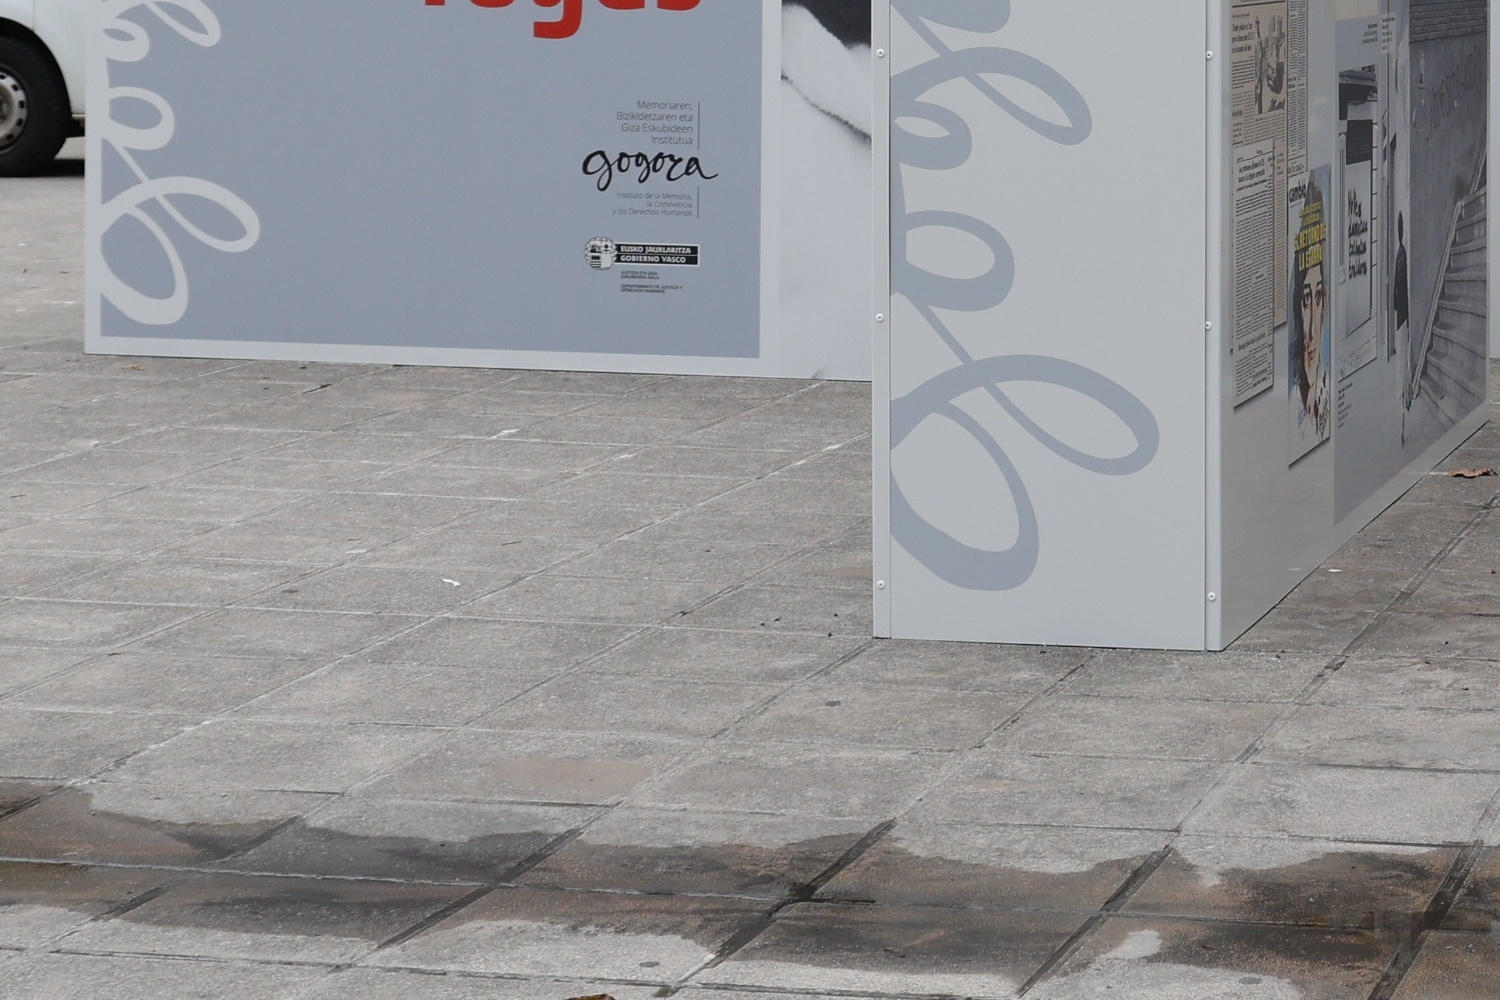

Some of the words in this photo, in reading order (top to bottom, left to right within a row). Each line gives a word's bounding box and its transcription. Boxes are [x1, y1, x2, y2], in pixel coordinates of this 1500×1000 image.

[637, 100, 693, 111] Memoriaren,
[616, 111, 677, 122] Bizikidetzaren
[679, 114, 693, 122] eta
[621, 123, 641, 132] Giza
[642, 123, 693, 133] Eskubideen
[651, 136, 693, 145] Institutua
[654, 200, 693, 209] Convivencia
[628, 208, 659, 216] Derechos
[661, 209, 693, 217] Humanos
[620, 246, 644, 255] EUSKO
[644, 246, 691, 255] JAURLARITZA
[620, 256, 660, 264] GOBIERNO
